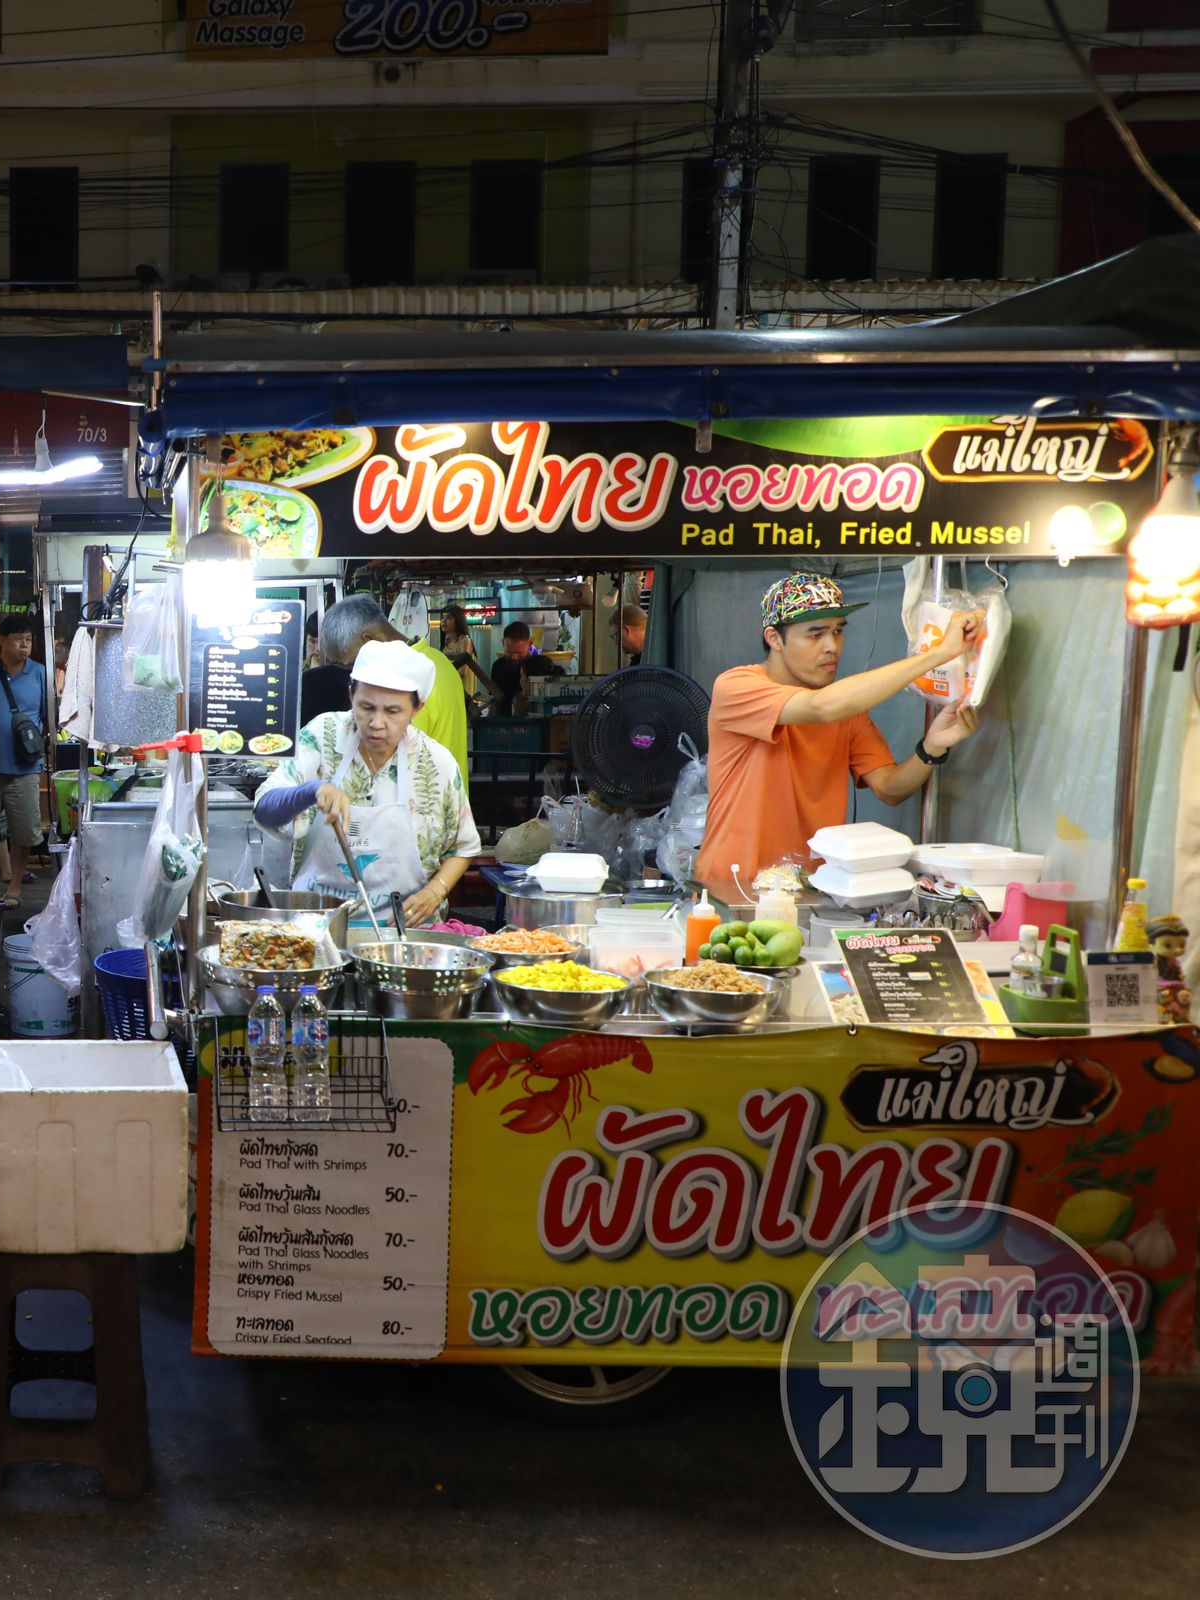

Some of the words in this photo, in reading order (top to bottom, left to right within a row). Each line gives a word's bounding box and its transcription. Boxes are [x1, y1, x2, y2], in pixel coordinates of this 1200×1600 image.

[207, 0, 293, 20] Galaxy
[194, 20, 305, 48] Massage
[76, 427, 108, 442] 70/3
[355, 421, 676, 536] ผัดไทย
[681, 461, 926, 513] หอยทอด
[681, 523, 734, 546] Pad
[753, 521, 822, 549] Thai,
[840, 520, 913, 546] Fried
[930, 520, 1032, 545] Mussel
[239, 1137, 319, 1159] ผัดไทยกุ้งสด
[386, 1143, 418, 1158] 70.-
[239, 1159, 261, 1169] Pad
[266, 1159, 291, 1170] Thai
[294, 1159, 320, 1170] with
[324, 1160, 368, 1172] Shrimps
[538, 1087, 1014, 1260] ผัดไทย
[385, 1187, 418, 1202] 50.-
[239, 1202, 261, 1212] Pad
[266, 1202, 289, 1214] Thai
[293, 1203, 322, 1215] Glass
[325, 1204, 370, 1215] Noodles
[384, 1233, 416, 1248] 70.-
[238, 1246, 260, 1256] Pad
[264, 1246, 288, 1257] Thai
[292, 1247, 321, 1258] Glass
[324, 1248, 369, 1260] Noodles
[238, 1260, 264, 1270] with
[268, 1260, 312, 1272] Shrimps
[237, 1272, 295, 1287] หอยทอด
[383, 1276, 415, 1291] 50.-
[237, 1288, 270, 1301] Crispy
[274, 1288, 302, 1301] Fried
[305, 1290, 343, 1302] Mussel
[469, 1282, 788, 1347] หอยทอด
[236, 1316, 295, 1332] ทะเลทอด
[381, 1320, 413, 1335] 80.-
[235, 1332, 269, 1344] Crispy
[273, 1333, 301, 1344] Fried
[305, 1334, 352, 1345] Seafood
